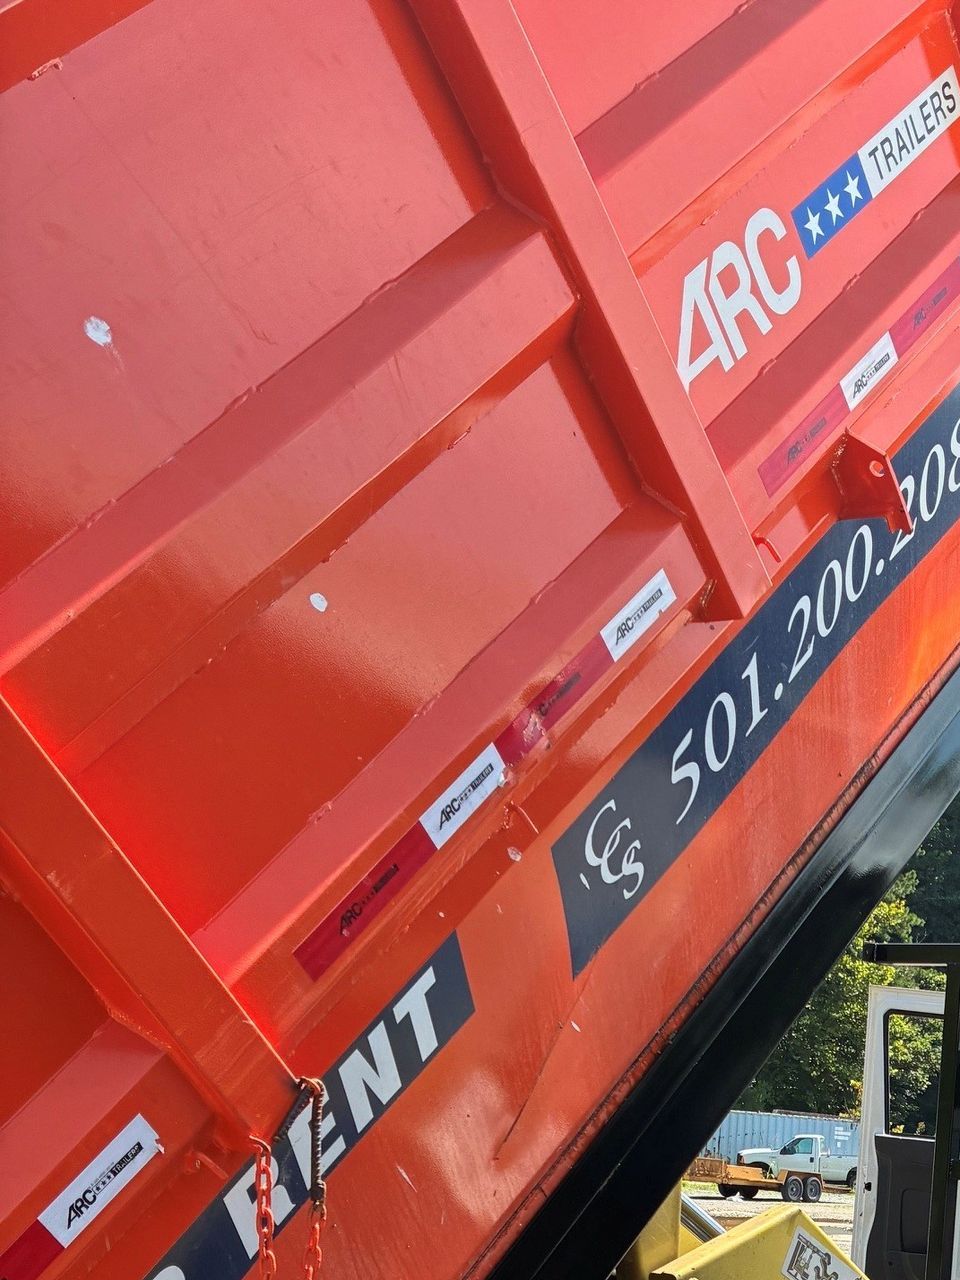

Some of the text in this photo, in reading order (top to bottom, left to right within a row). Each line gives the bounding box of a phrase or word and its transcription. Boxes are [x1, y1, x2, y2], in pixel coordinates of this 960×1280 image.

[676, 81, 957, 394] ARC TRAILERS
[853, 375, 868, 399] ARC
[615, 617, 634, 646] ARC
[440, 798, 461, 831] ARC
[222, 965, 437, 1260] RENT
[67, 1144, 140, 1230] ARC TRAILERS
